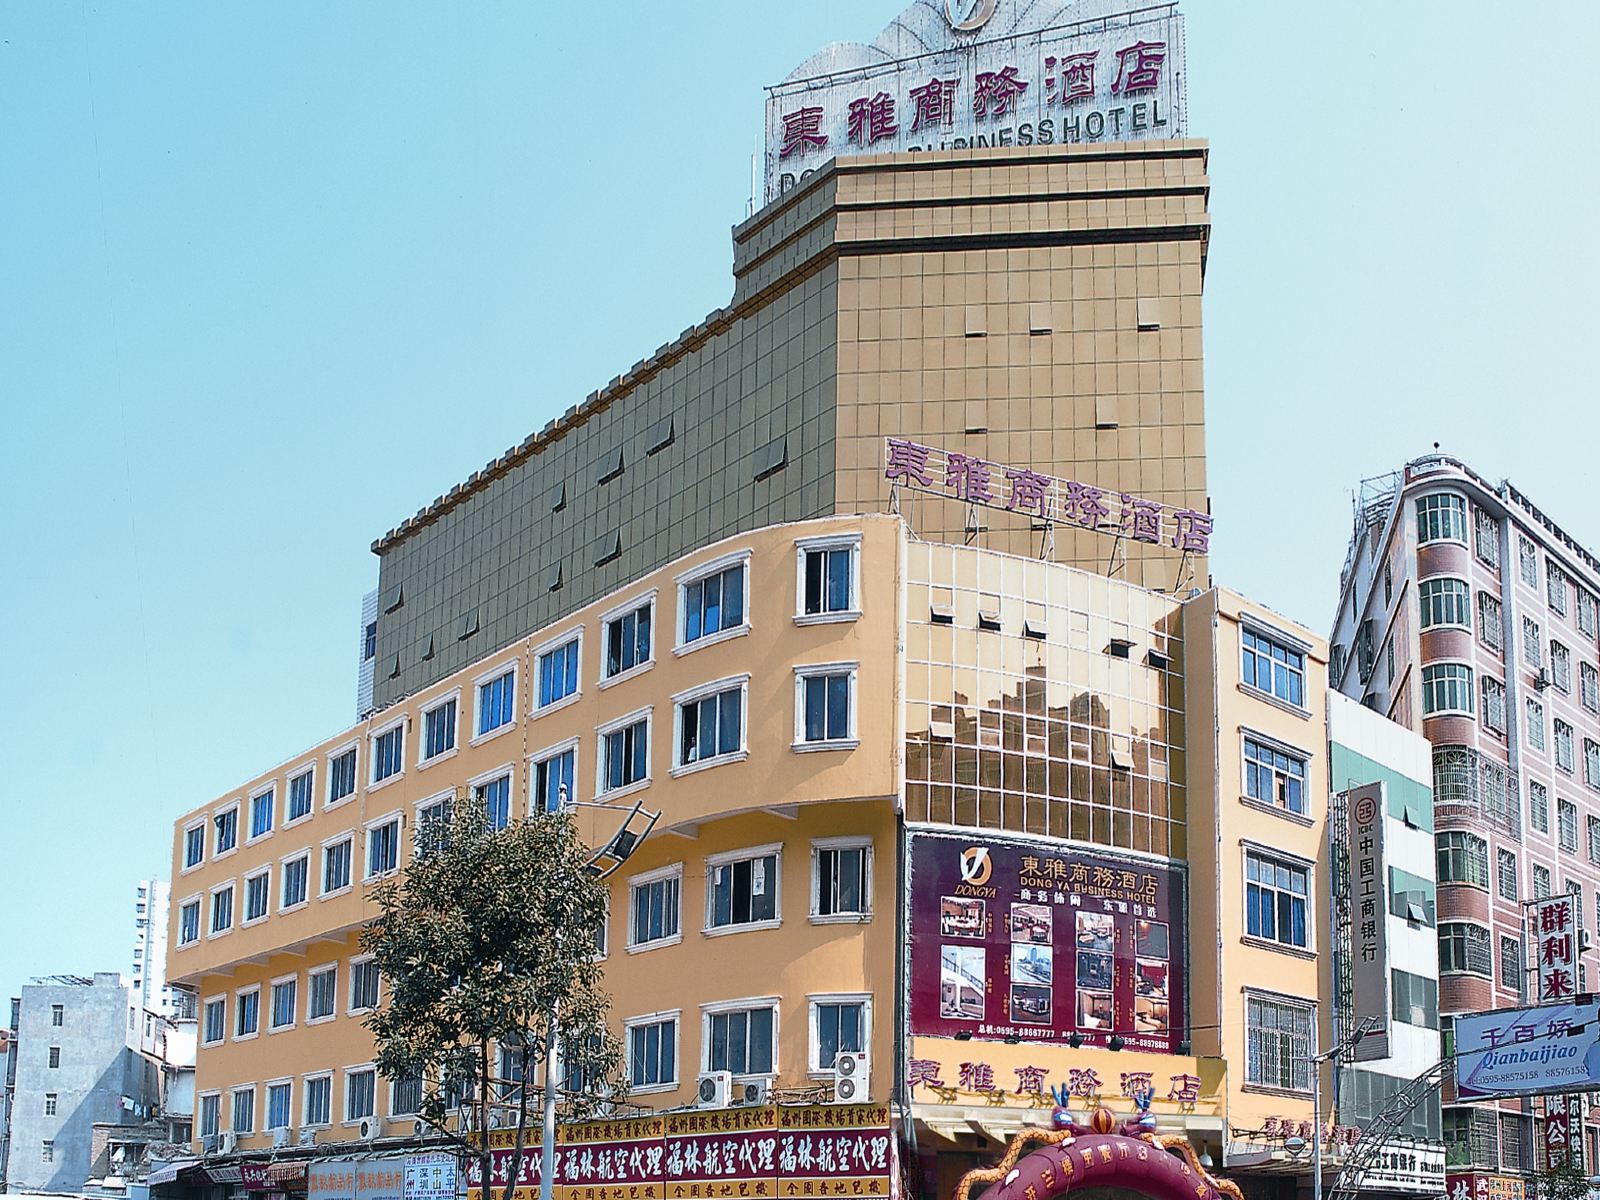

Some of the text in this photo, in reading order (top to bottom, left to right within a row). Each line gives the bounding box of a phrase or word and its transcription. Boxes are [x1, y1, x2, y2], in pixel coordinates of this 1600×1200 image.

[779, 39, 1167, 158] 東雅商務酒店
[1063, 99, 1167, 145] HOTEL
[884, 438, 1215, 556] 東雅商務酒店
[953, 883, 998, 900] DONGYA
[1018, 855, 1159, 896] 東雅商務酒店
[1020, 876, 1158, 905] DONG YA BUSINESS HOTEL
[1358, 836, 1378, 963] 中国工商银行
[1539, 901, 1575, 1000] 群利来
[1481, 1043, 1578, 1071] Qianbaijiao
[1545, 1065, 1586, 1079] 88576158
[906, 1058, 1202, 1102] 東雅商務酒店
[564, 1145, 663, 1182] 福林航空代理
[667, 1136, 777, 1177] 福林航空代理
[779, 1134, 889, 1174] 福林航空代理
